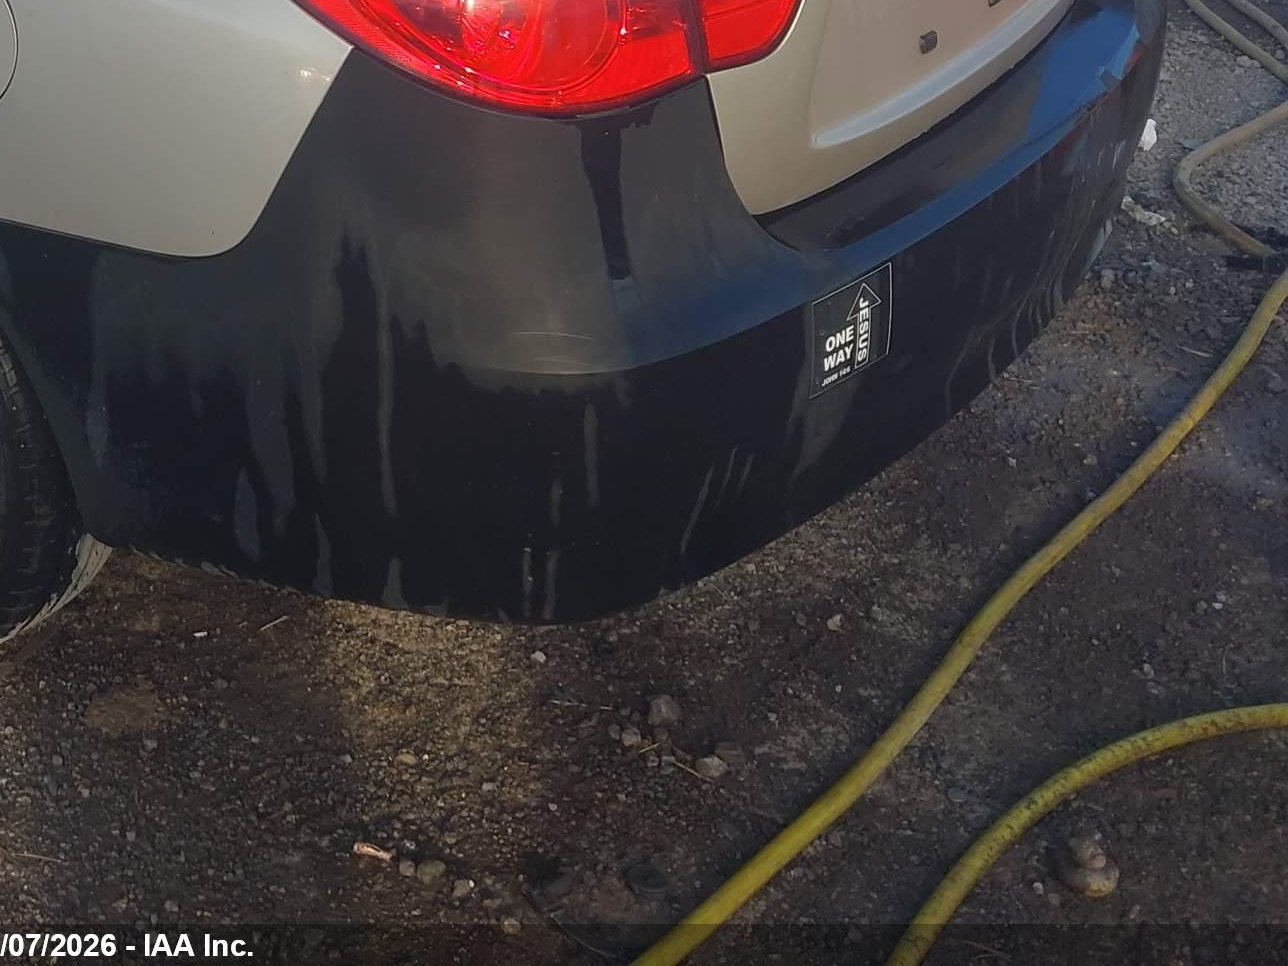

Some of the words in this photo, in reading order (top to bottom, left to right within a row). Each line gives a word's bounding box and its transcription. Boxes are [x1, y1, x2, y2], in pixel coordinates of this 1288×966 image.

[825, 325, 855, 352] ONE
[857, 297, 869, 361] JESUS
[824, 343, 854, 371] WAY
